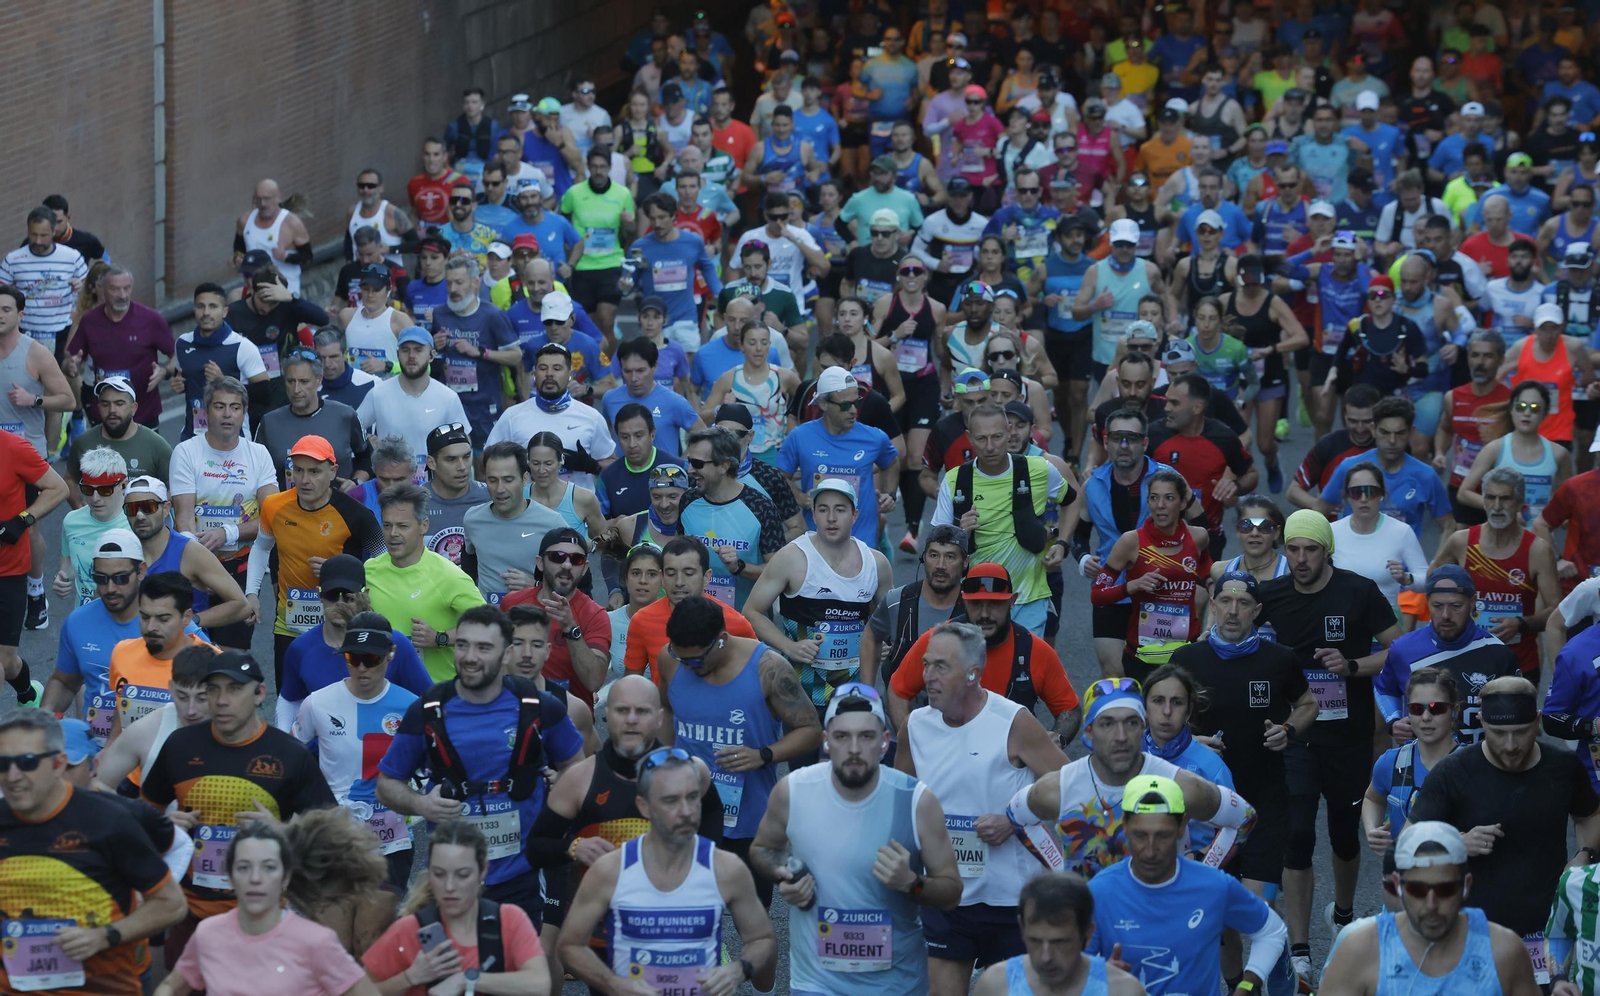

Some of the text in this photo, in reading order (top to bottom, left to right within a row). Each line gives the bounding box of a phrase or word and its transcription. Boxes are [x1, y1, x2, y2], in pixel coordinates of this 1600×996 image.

[830, 467, 856, 475] ZURICH
[206, 508, 235, 516] ZURICH
[1157, 606, 1184, 615] ZURICH
[833, 623, 860, 632] ZURICH
[1152, 628, 1173, 639] ANA
[829, 648, 848, 659] ROB
[139, 689, 171, 701] ZURICH
[678, 721, 744, 745] ATHLETE
[628, 916, 706, 926] ROAD RUNNERS
[842, 912, 882, 923] ZURICH
[843, 931, 865, 941] 9333
[825, 942, 885, 957] FLORENT
[28, 957, 59, 973] JAVI
[656, 953, 697, 966] ZURICH
